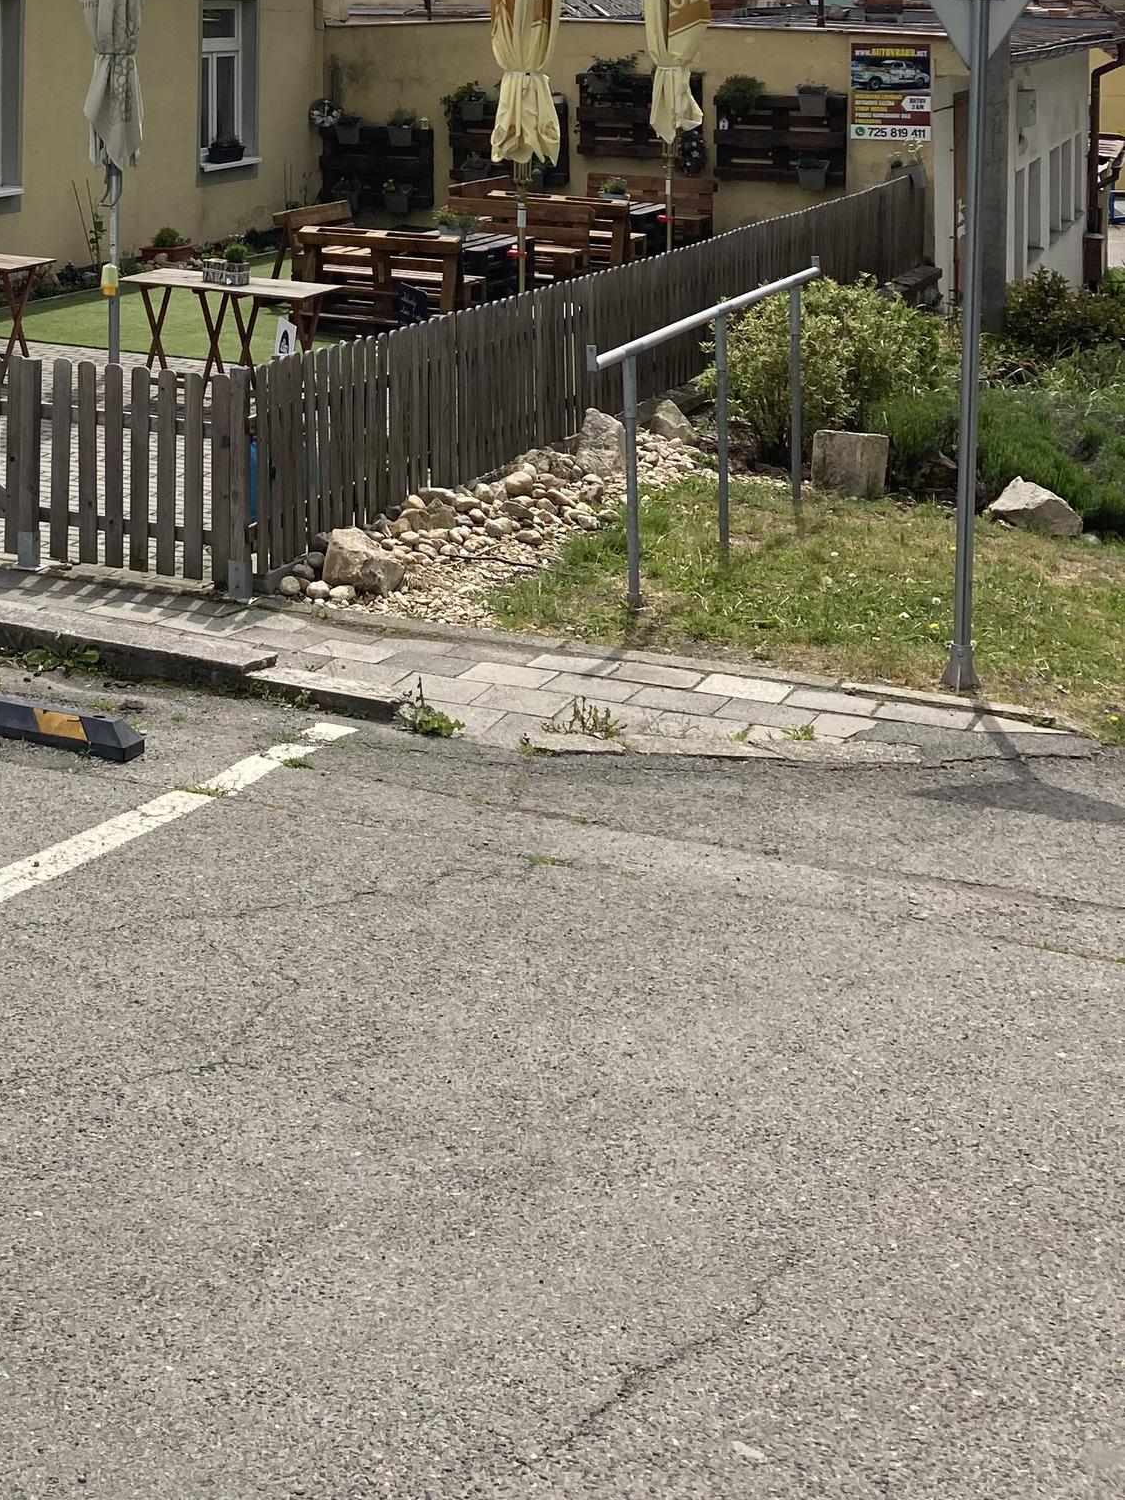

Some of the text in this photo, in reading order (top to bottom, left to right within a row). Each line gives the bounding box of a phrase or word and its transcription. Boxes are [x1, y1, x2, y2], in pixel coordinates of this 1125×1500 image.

[868, 128, 926, 138] 725 819 411
